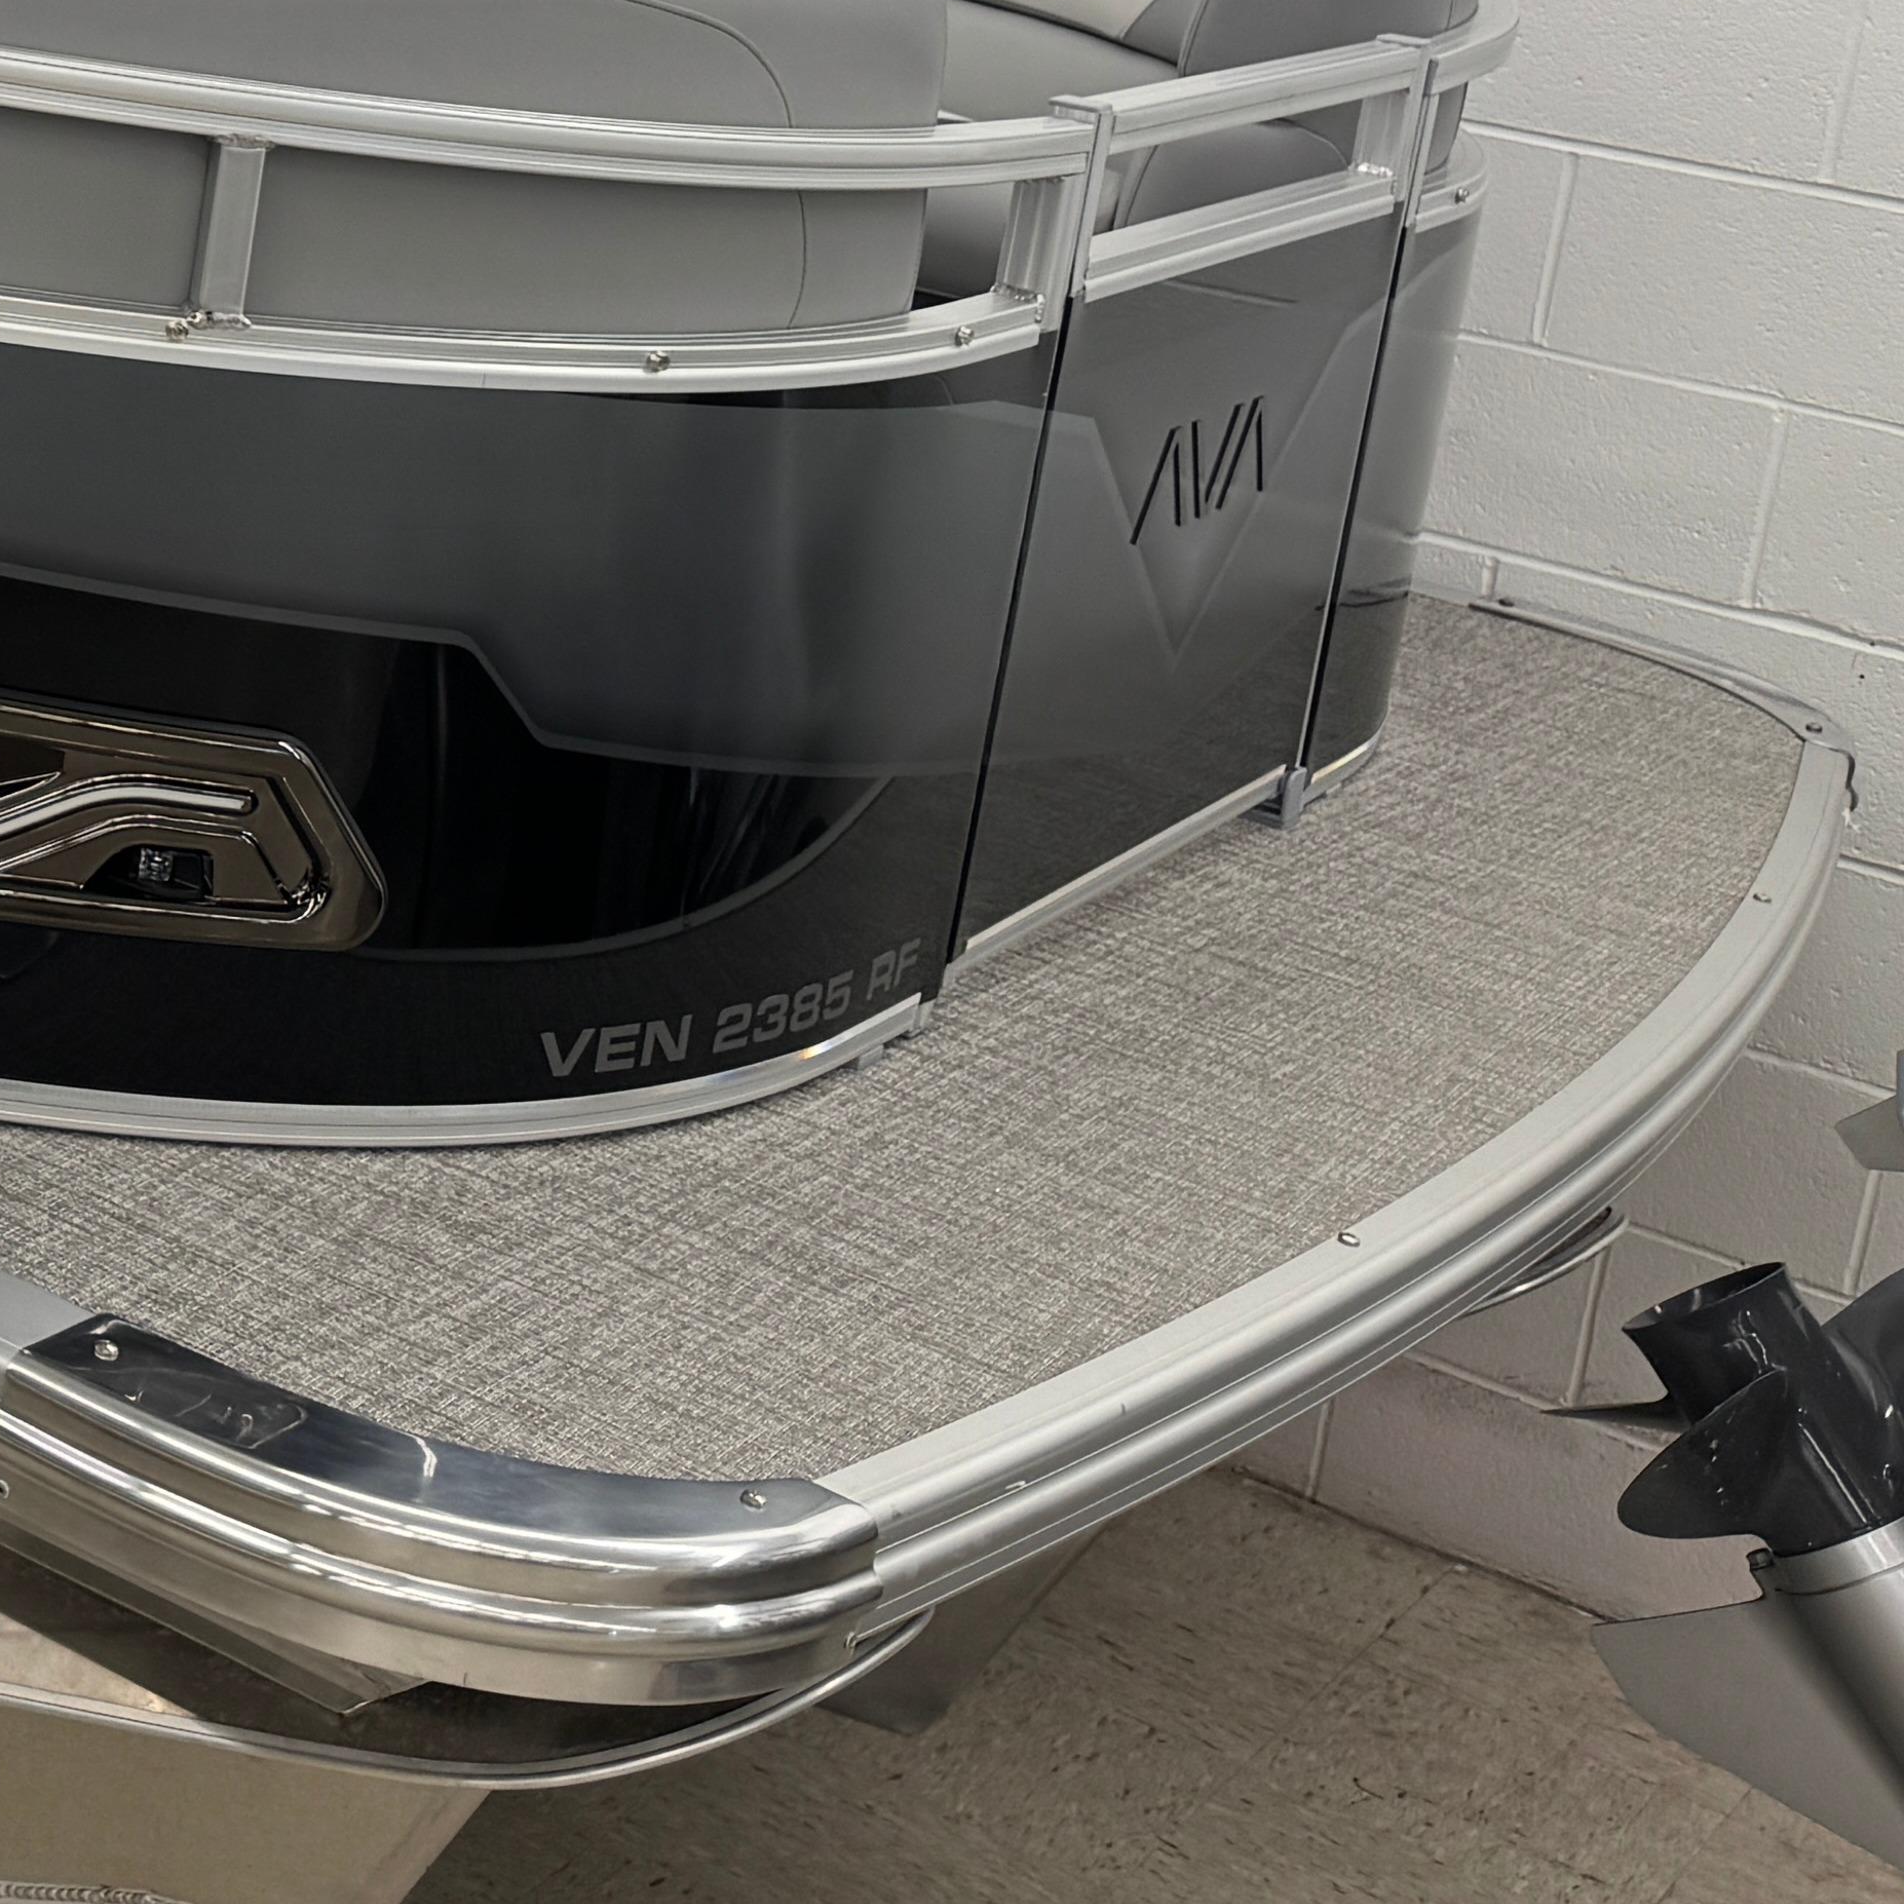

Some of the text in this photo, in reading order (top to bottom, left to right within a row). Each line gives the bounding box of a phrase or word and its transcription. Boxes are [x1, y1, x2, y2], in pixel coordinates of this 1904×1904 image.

[1128, 394, 1266, 546] AVA
[539, 937, 922, 1078] VEN 2385 RF
